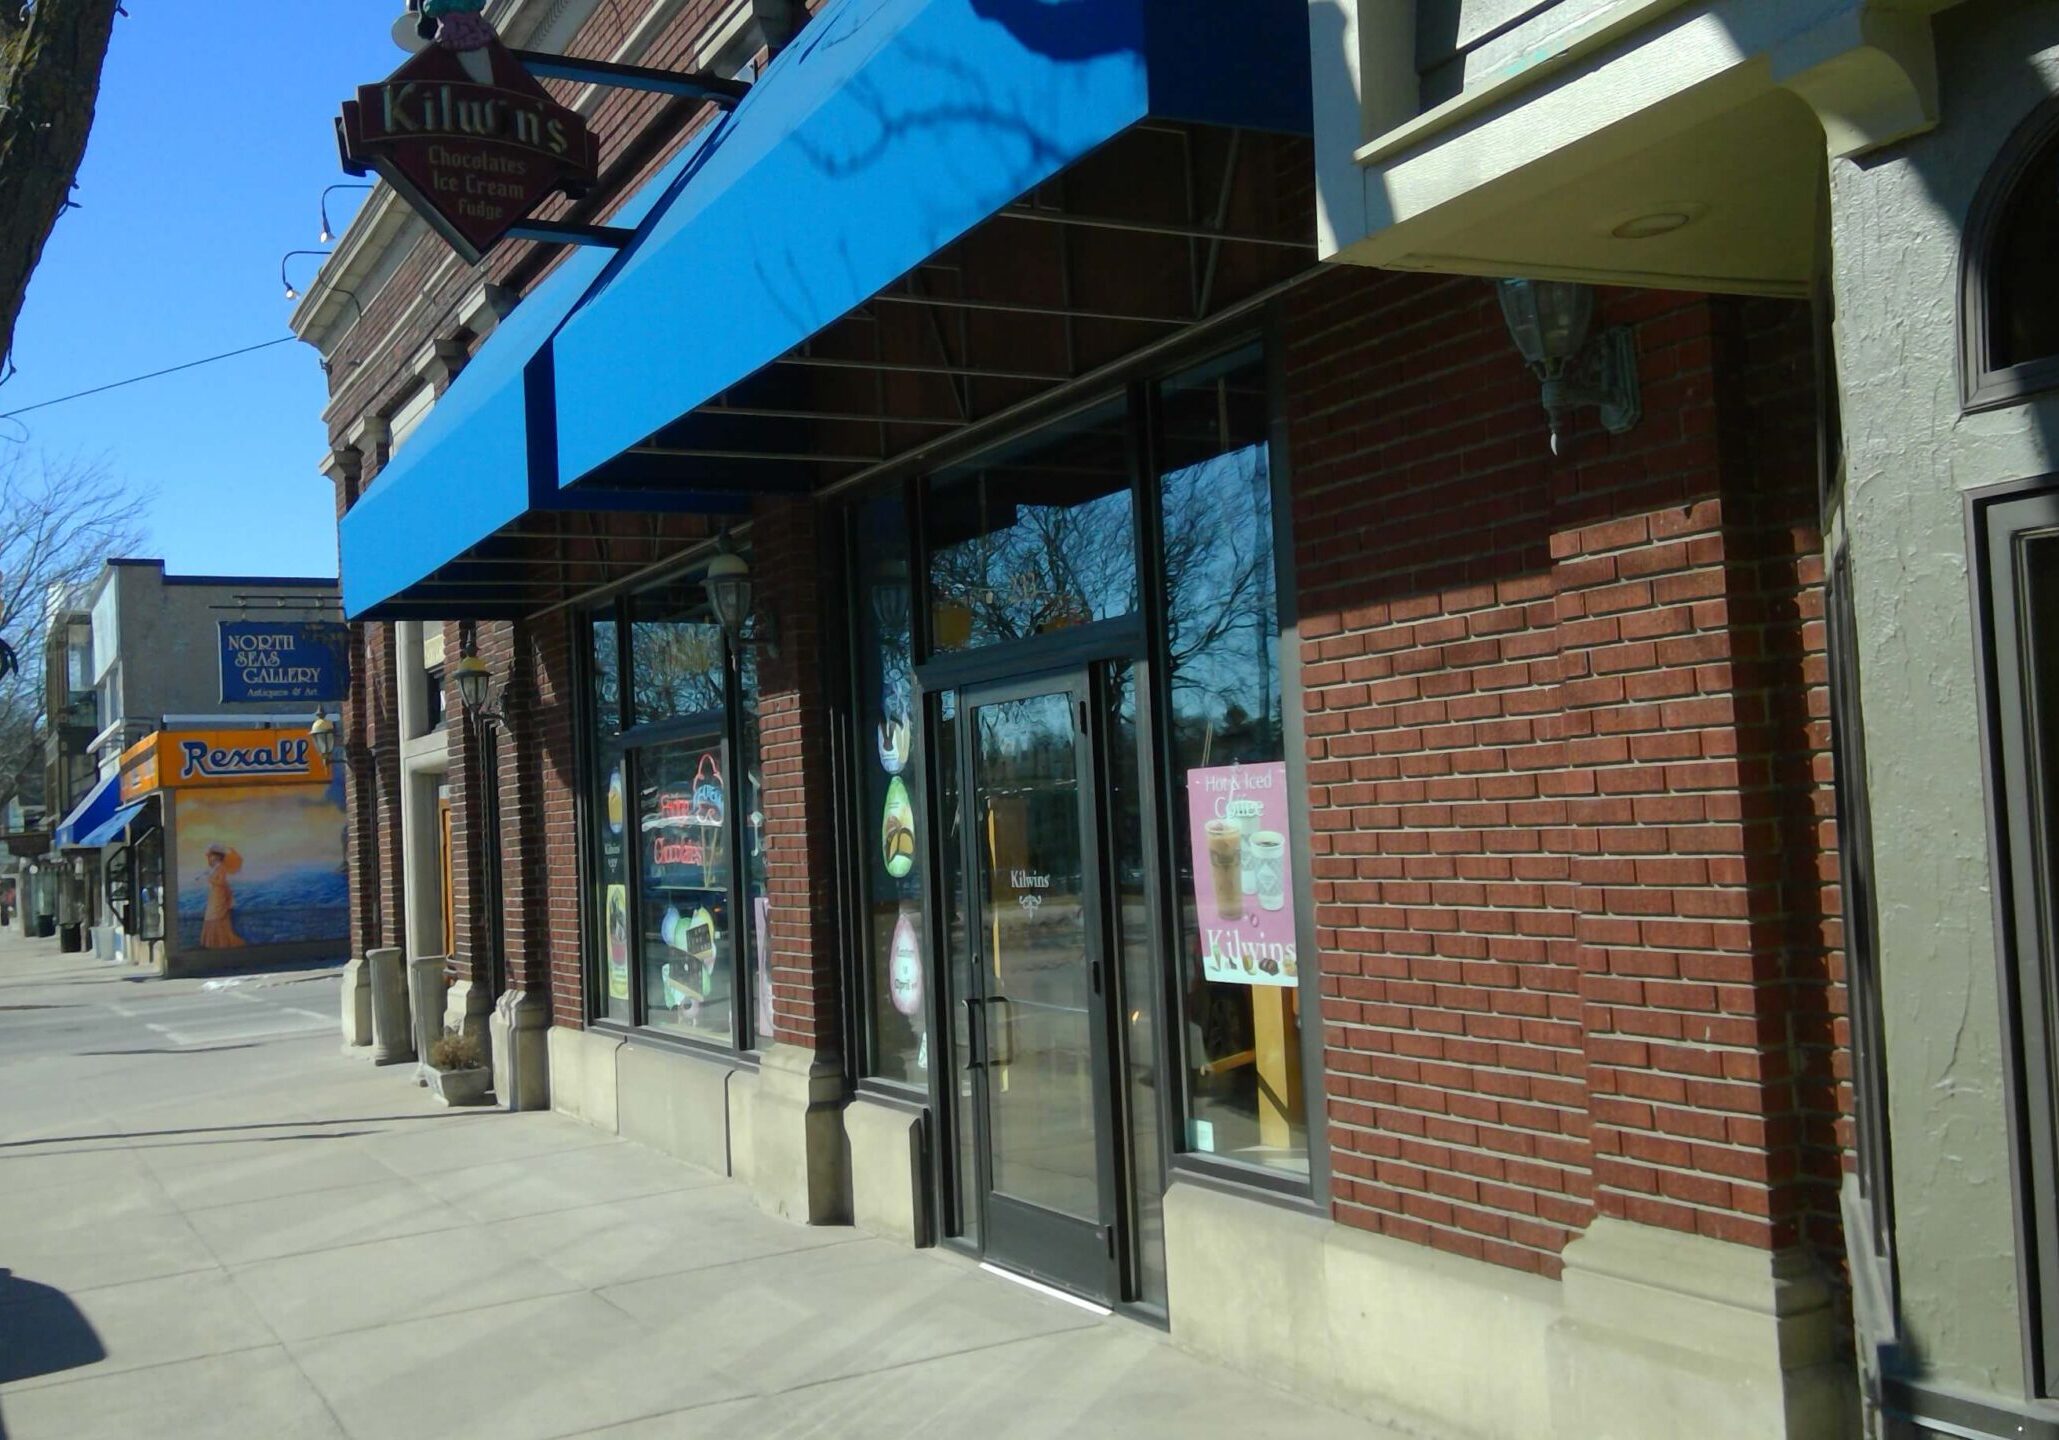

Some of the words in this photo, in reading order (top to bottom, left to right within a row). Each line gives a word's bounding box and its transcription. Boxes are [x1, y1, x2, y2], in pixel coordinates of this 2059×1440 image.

[383, 82, 568, 155] Kilwn's
[428, 144, 528, 176] Chocolates
[433, 169, 459, 191] Ice
[465, 175, 525, 199] Cream
[458, 197, 503, 220] Fudge
[228, 635, 295, 650] NORTH
[234, 651, 280, 667] SEAS
[242, 668, 321, 684] GALLERY
[180, 738, 312, 778] Rexall
[1206, 775, 1227, 792] Hot
[1244, 769, 1272, 789] Iced
[1206, 928, 1296, 965] Kilwins
